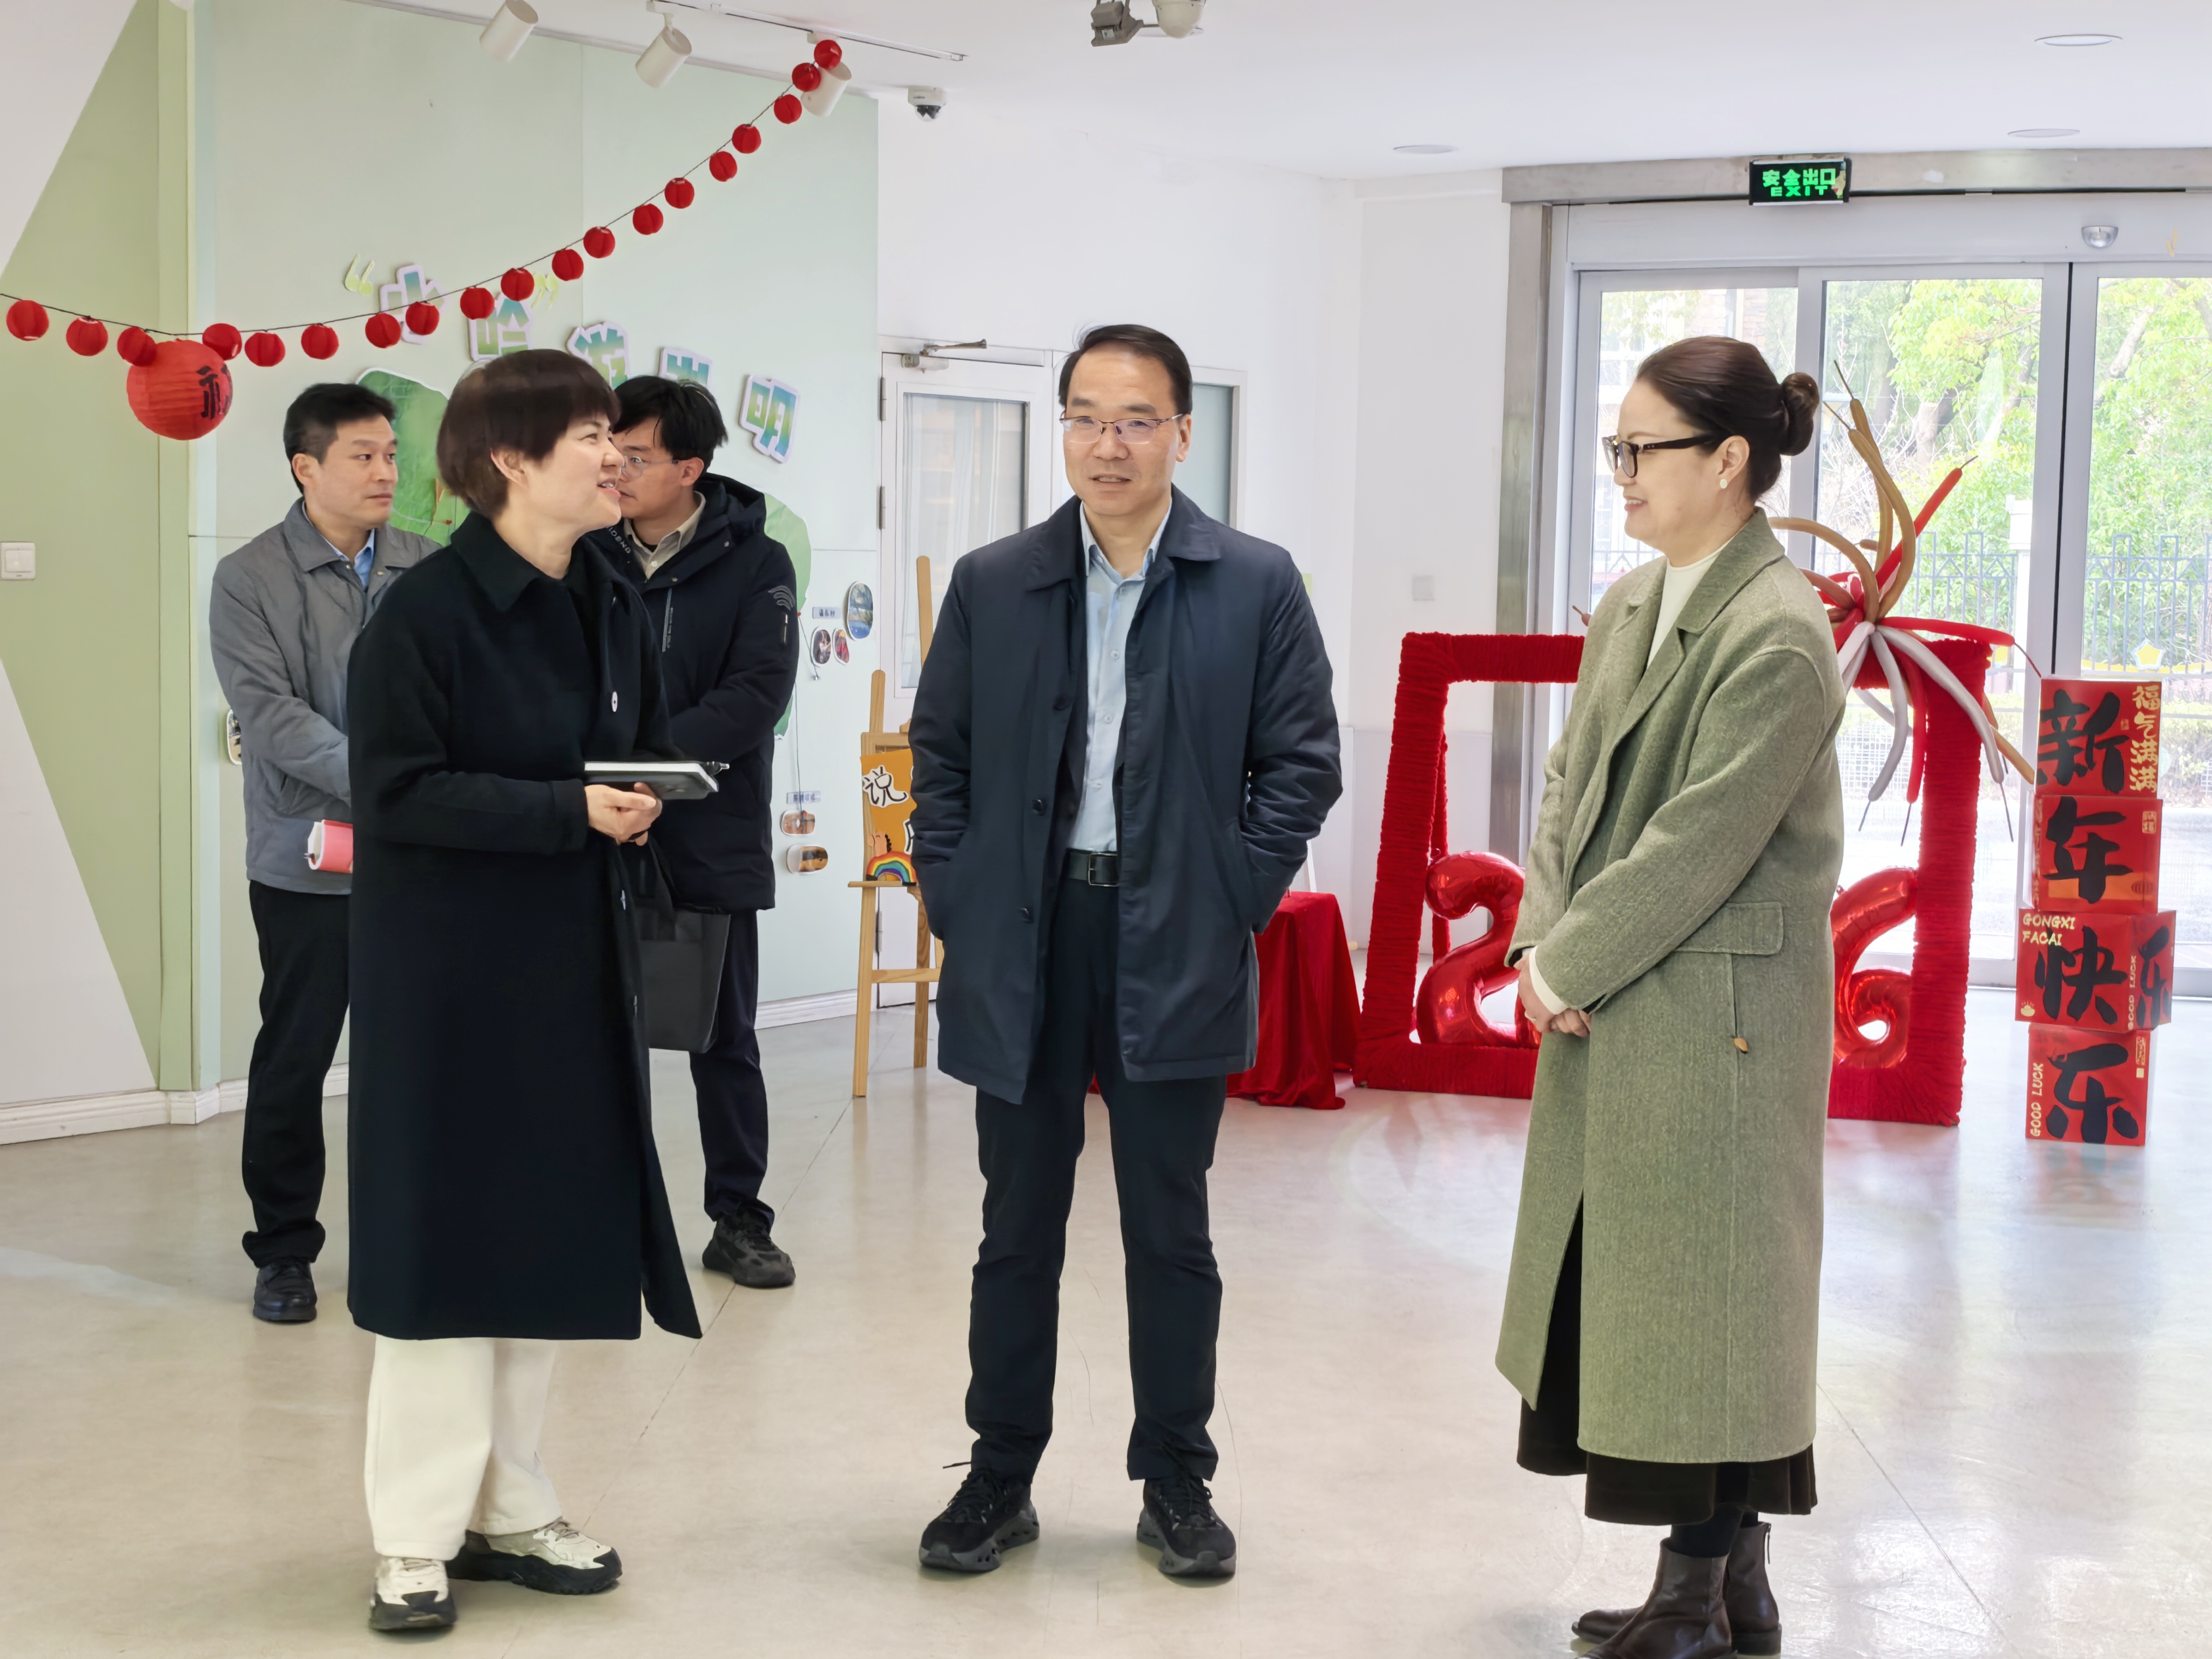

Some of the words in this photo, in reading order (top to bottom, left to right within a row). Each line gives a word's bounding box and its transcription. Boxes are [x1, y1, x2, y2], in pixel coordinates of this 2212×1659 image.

[1763, 168, 1836, 187] 安全出口
[1771, 186, 1828, 197] EXIT
[2037, 689, 2129, 794] 新
[2129, 685, 2161, 793] 福气满满
[864, 766, 907, 807] 说
[2042, 797, 2133, 904] 年
[2022, 913, 2075, 929] GONGXI
[2022, 930, 2062, 946] FACAI
[2034, 925, 2128, 1025] 快
[2031, 1062, 2044, 1097] LUCK
[2046, 1043, 2140, 1144] 乐
[2029, 1102, 2042, 1137] GOOD
